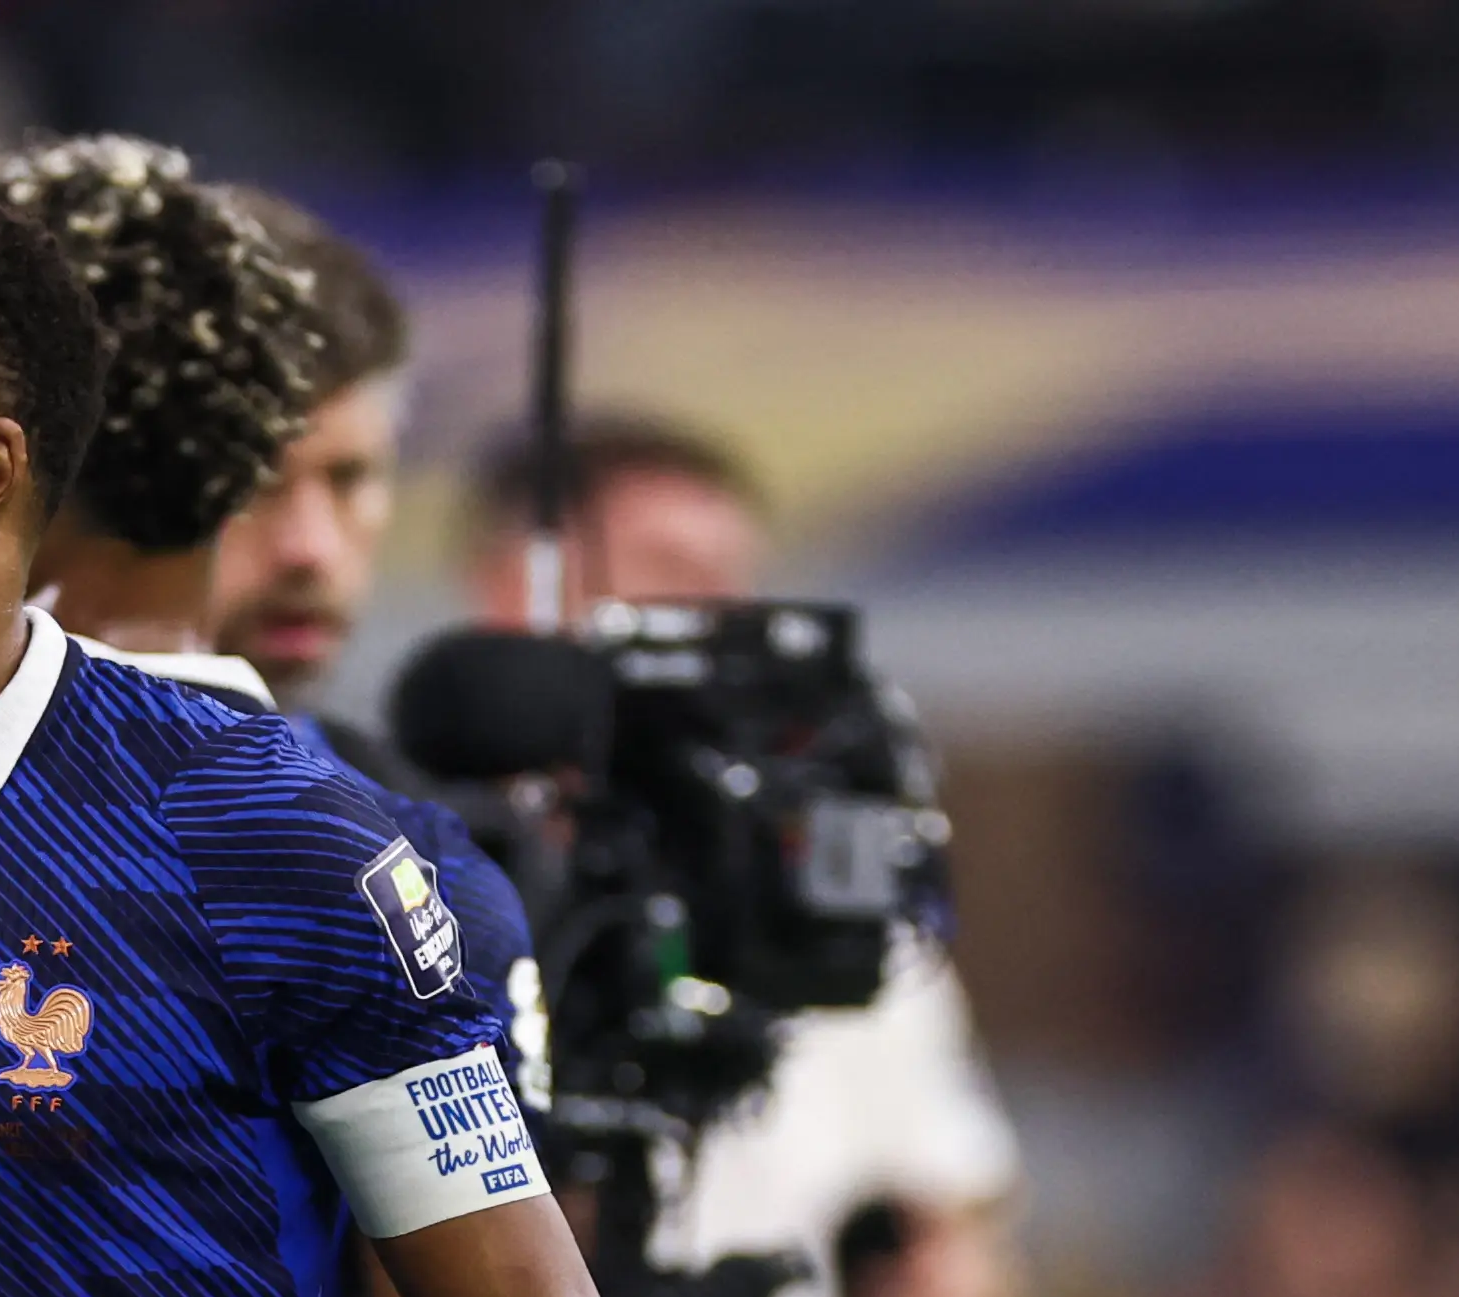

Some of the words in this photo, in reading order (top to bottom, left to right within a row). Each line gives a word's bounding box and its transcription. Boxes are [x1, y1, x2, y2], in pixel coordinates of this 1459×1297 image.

[405, 1058, 504, 1107] FOOTBALL
[11, 1094, 63, 1113] FFF
[417, 1086, 520, 1141] UNITES
[427, 1142, 479, 1177] the
[486, 1166, 526, 1191] FIFA
